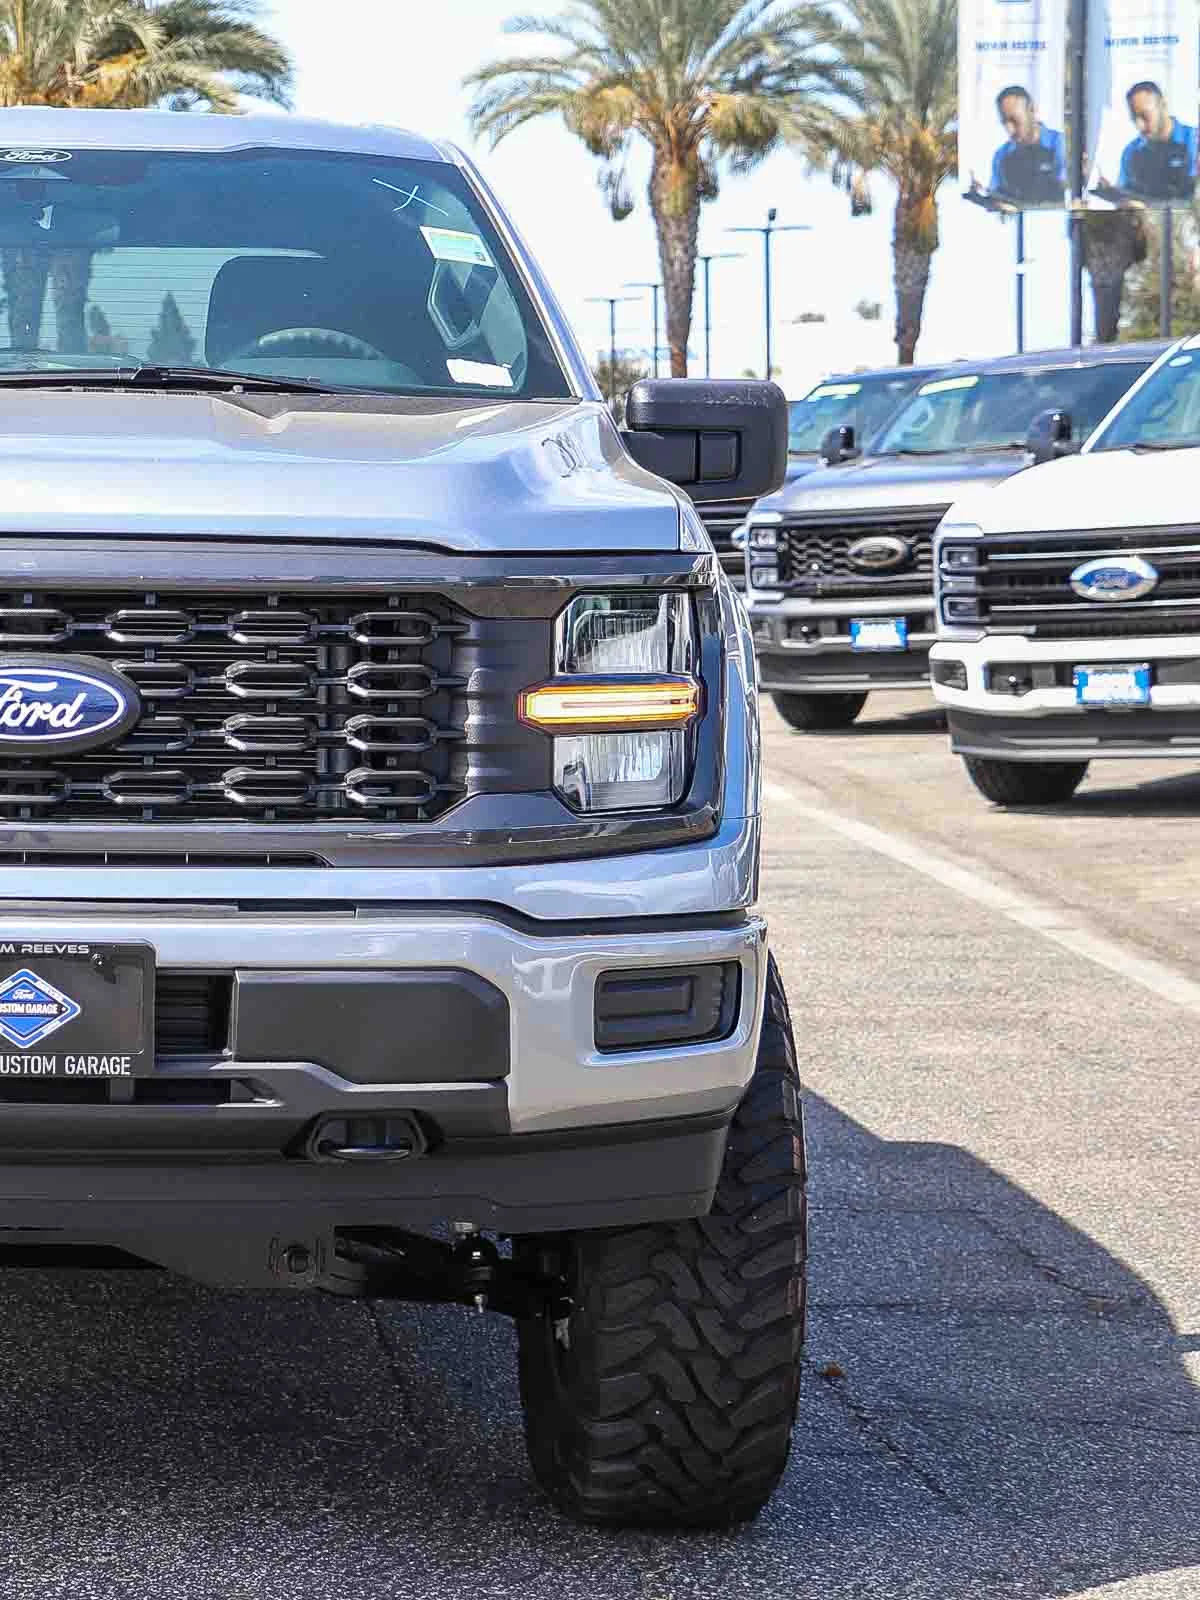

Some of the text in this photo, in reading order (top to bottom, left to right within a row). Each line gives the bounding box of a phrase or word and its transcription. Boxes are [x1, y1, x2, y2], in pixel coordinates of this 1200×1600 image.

[21, 944, 90, 955] REEVES
[11, 988, 36, 1000] Ford
[26, 1003, 59, 1015] GARAGE
[64, 1055, 131, 1076] GARAGE
